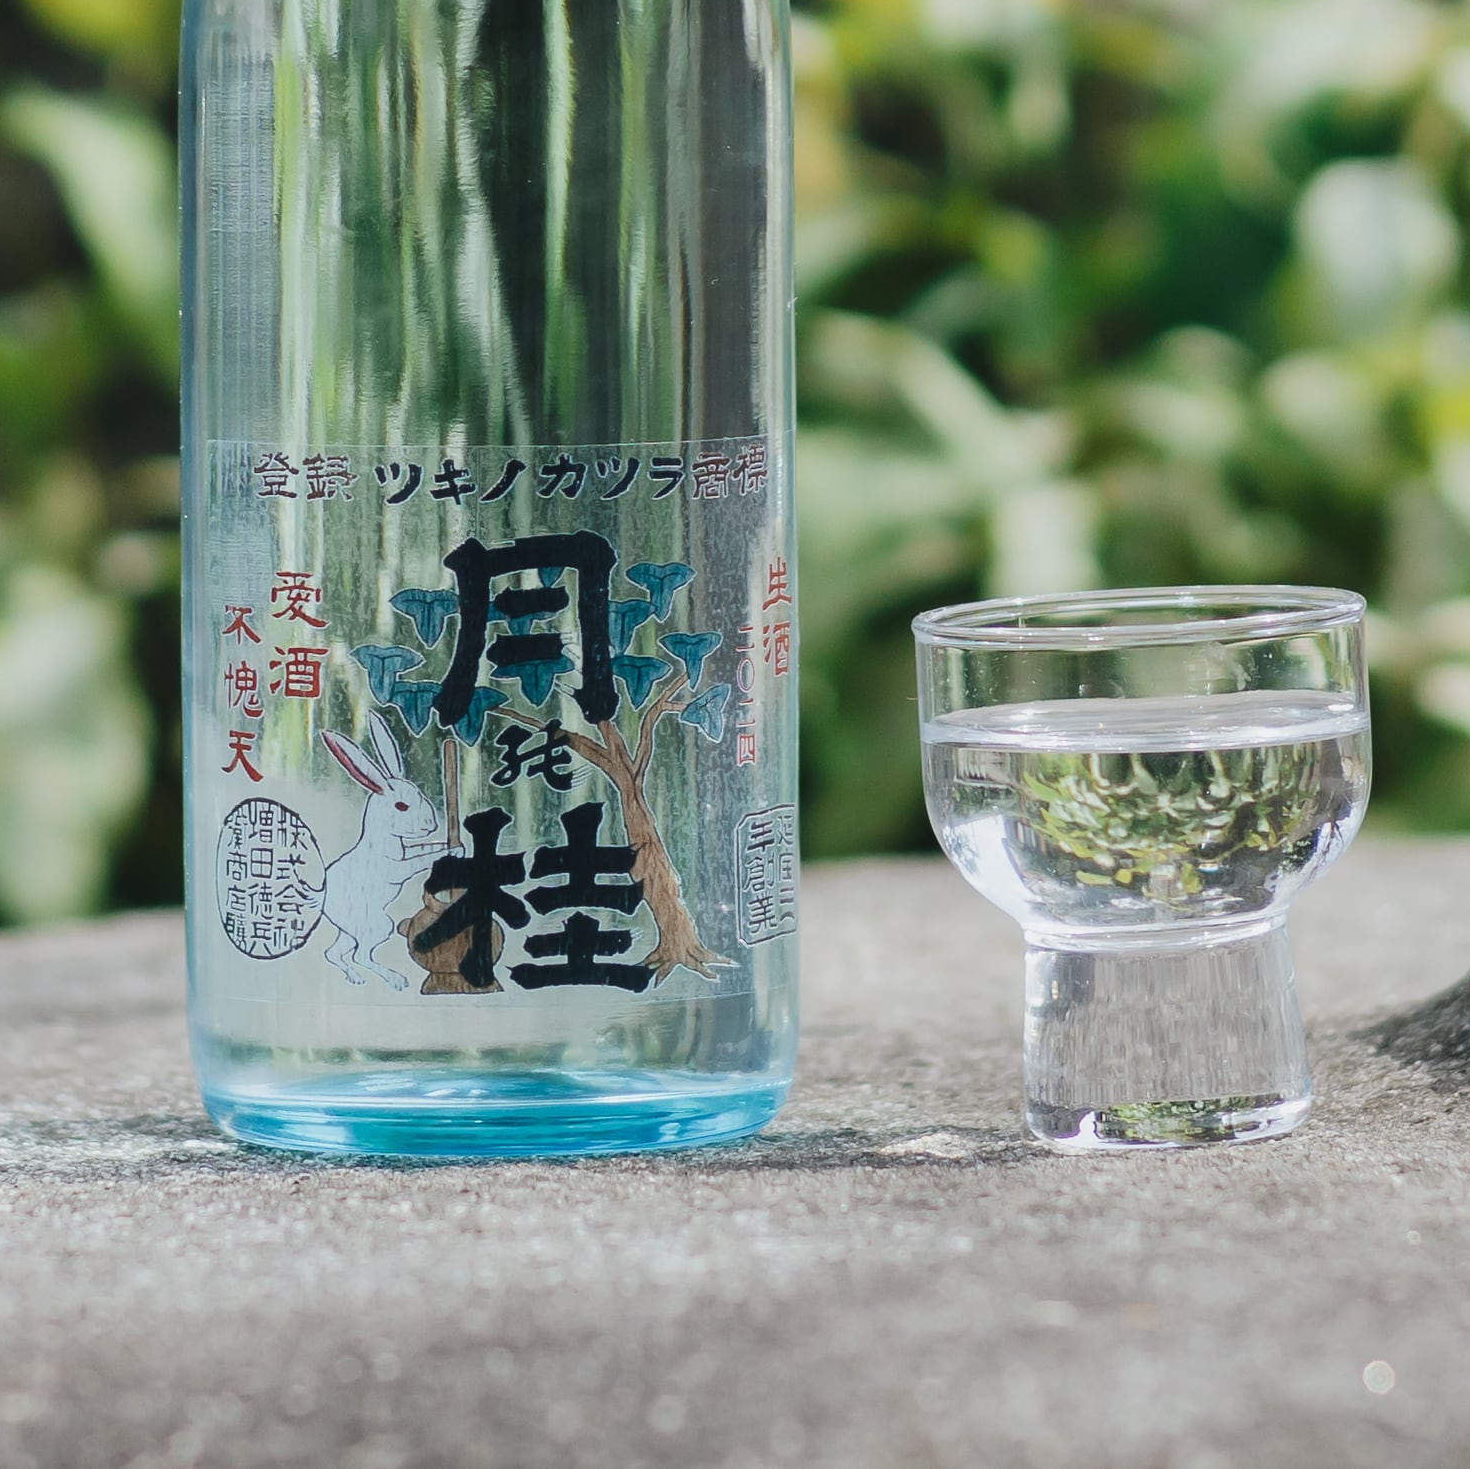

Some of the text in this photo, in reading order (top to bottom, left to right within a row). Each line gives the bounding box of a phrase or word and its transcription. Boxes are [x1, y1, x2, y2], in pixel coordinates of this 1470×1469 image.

[254, 443, 768, 504] 登録 ツキノカツラ 商標
[270, 571, 330, 698] 愛酒
[762, 556, 792, 676] 生酒
[221, 604, 264, 782] 不愧天
[743, 820, 777, 934] 年創業
